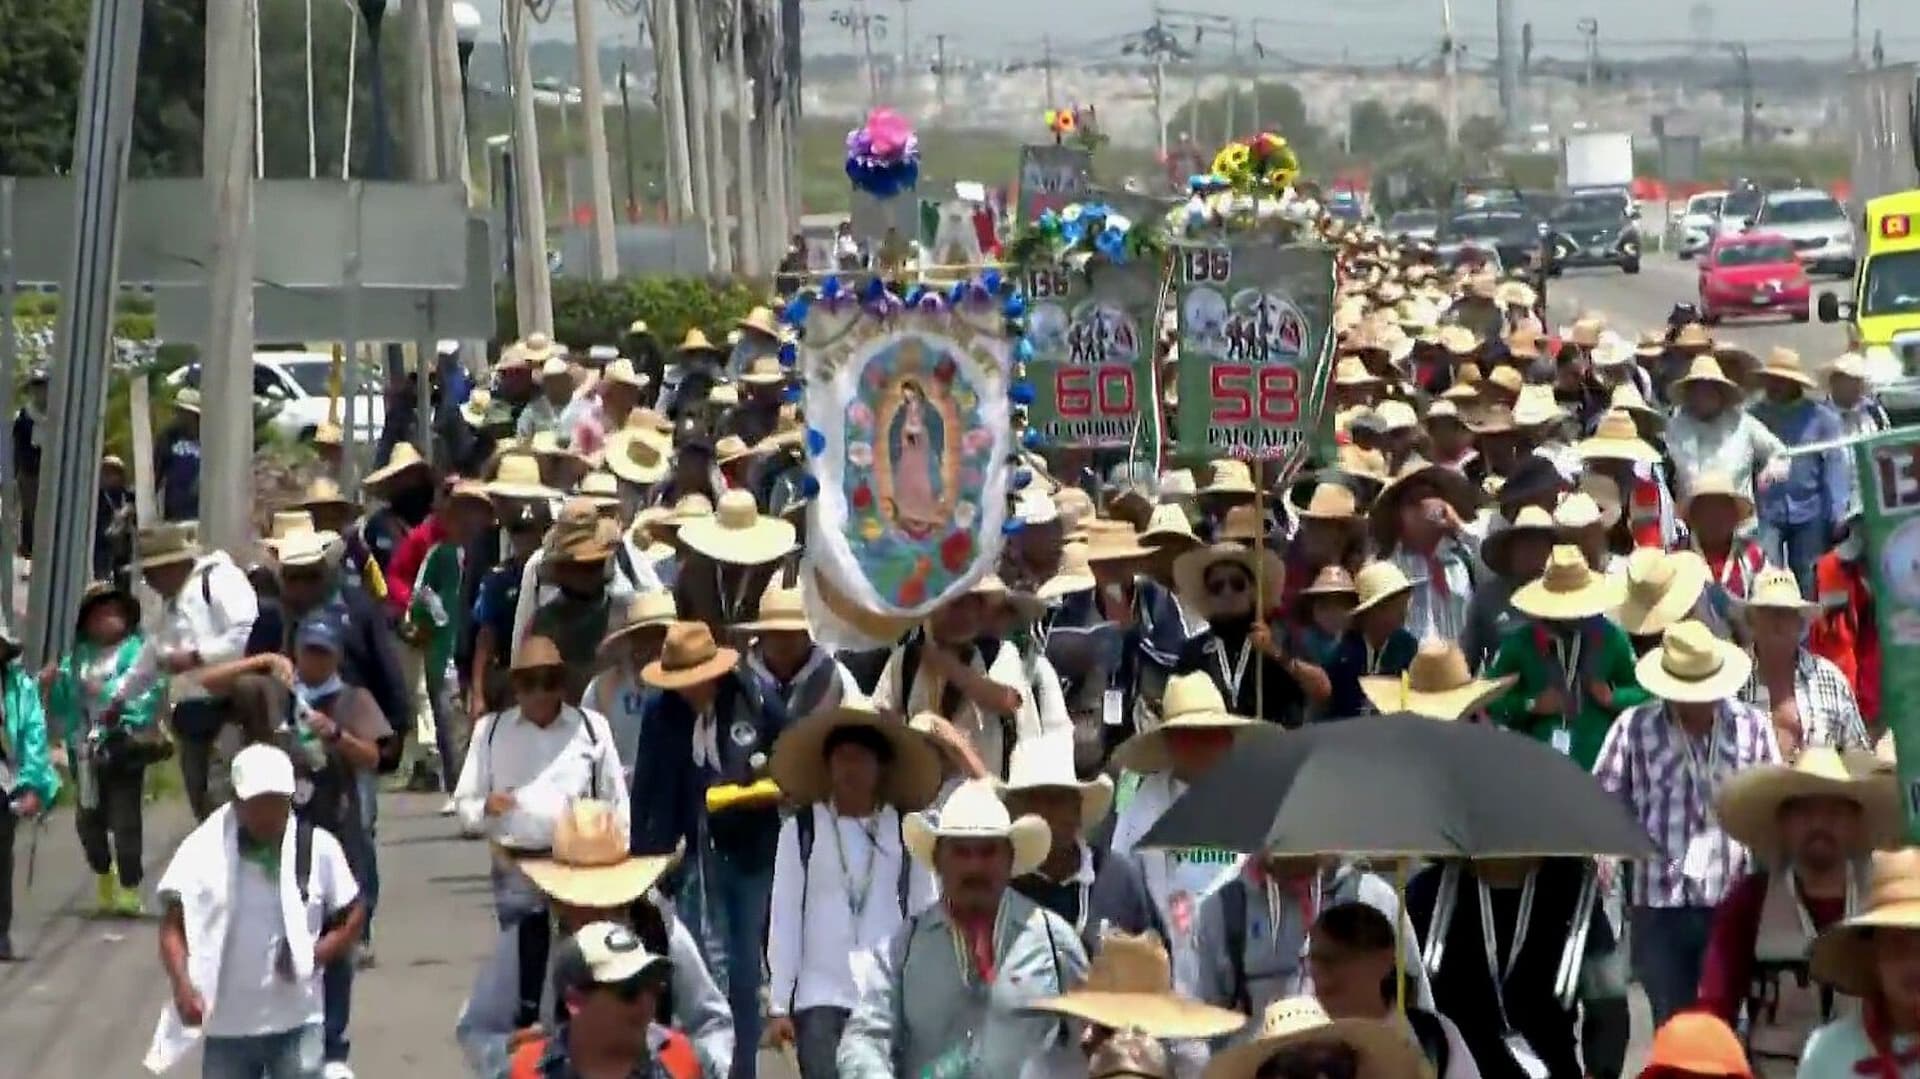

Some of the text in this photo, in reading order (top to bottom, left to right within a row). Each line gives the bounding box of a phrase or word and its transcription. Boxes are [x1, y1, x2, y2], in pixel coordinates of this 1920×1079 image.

[1028, 269, 1070, 300] 136
[1183, 247, 1231, 283] 136
[1055, 363, 1136, 418] 60
[1210, 363, 1301, 426] 58
